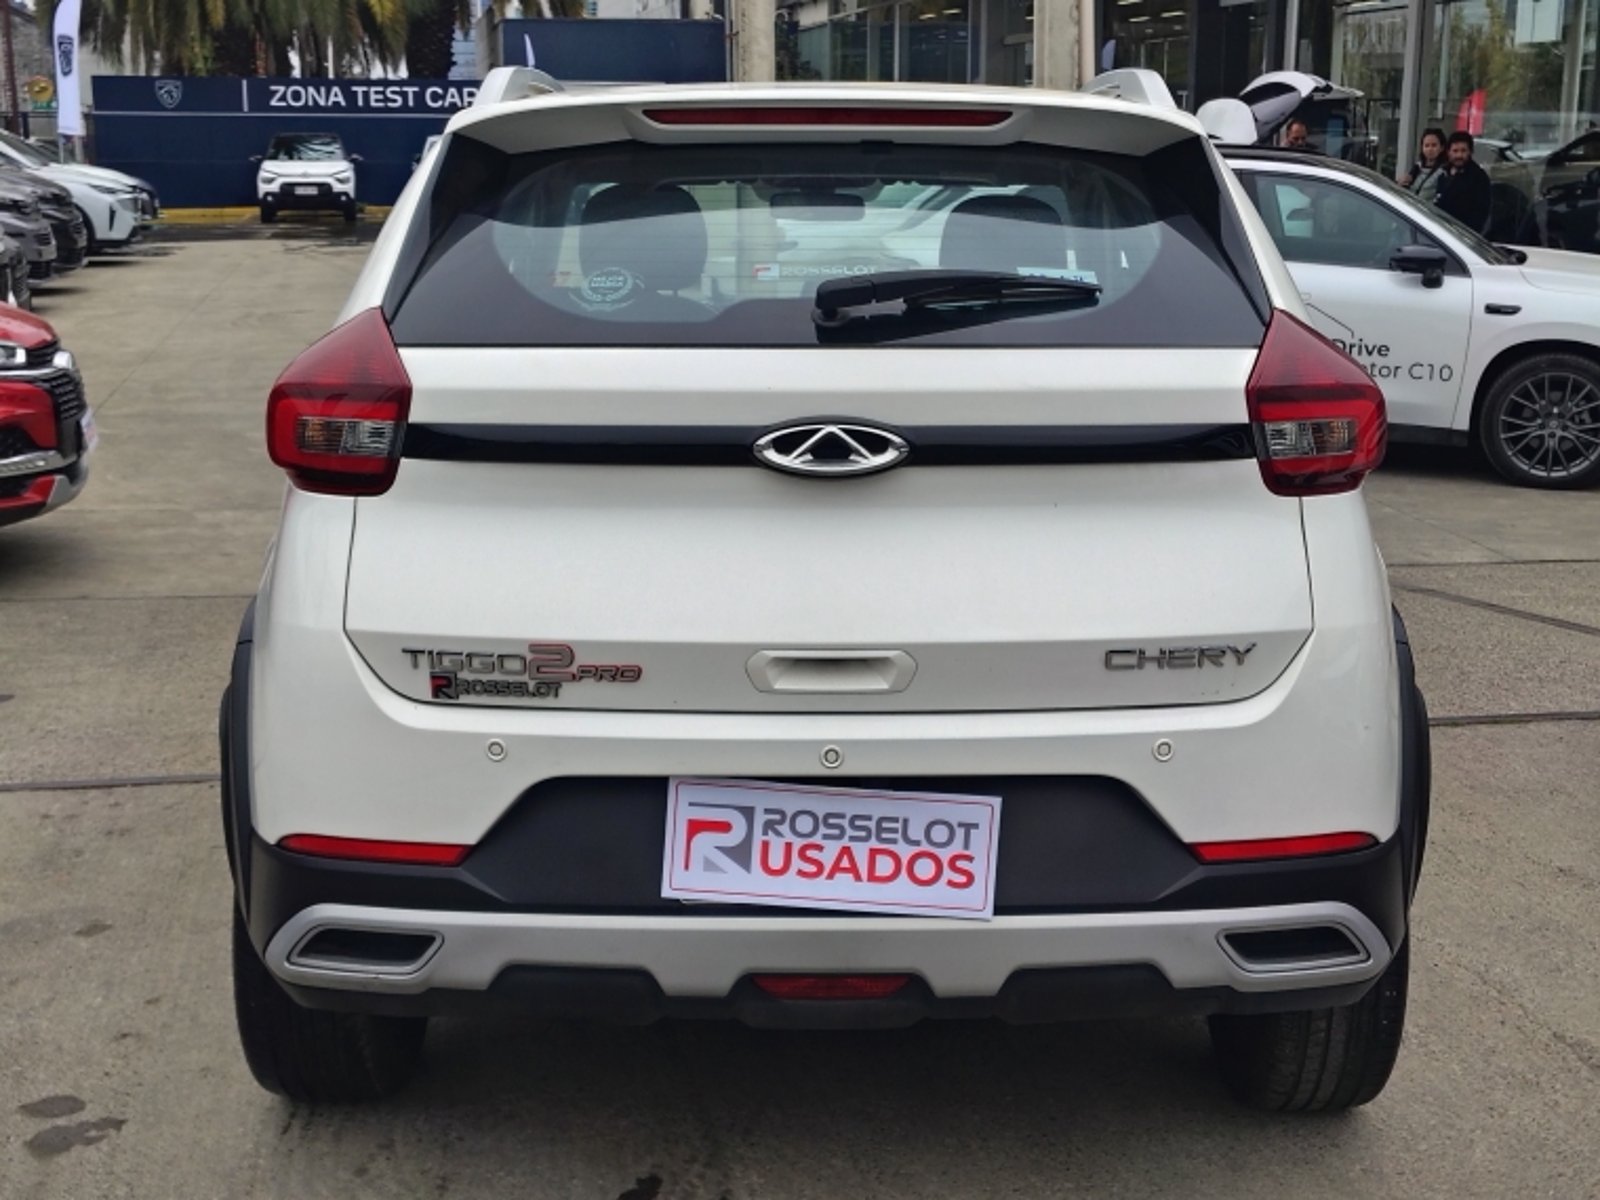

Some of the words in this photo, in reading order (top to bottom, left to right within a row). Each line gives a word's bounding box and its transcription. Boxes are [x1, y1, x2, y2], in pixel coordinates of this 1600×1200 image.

[269, 86, 346, 107] ZONA
[351, 87, 419, 107] TEST
[1408, 361, 1453, 382] C10
[1104, 641, 1258, 671] CHERY
[457, 679, 564, 699] ROSSELOT
[760, 807, 980, 851] ROSSELOT
[759, 839, 976, 890] USADOS
